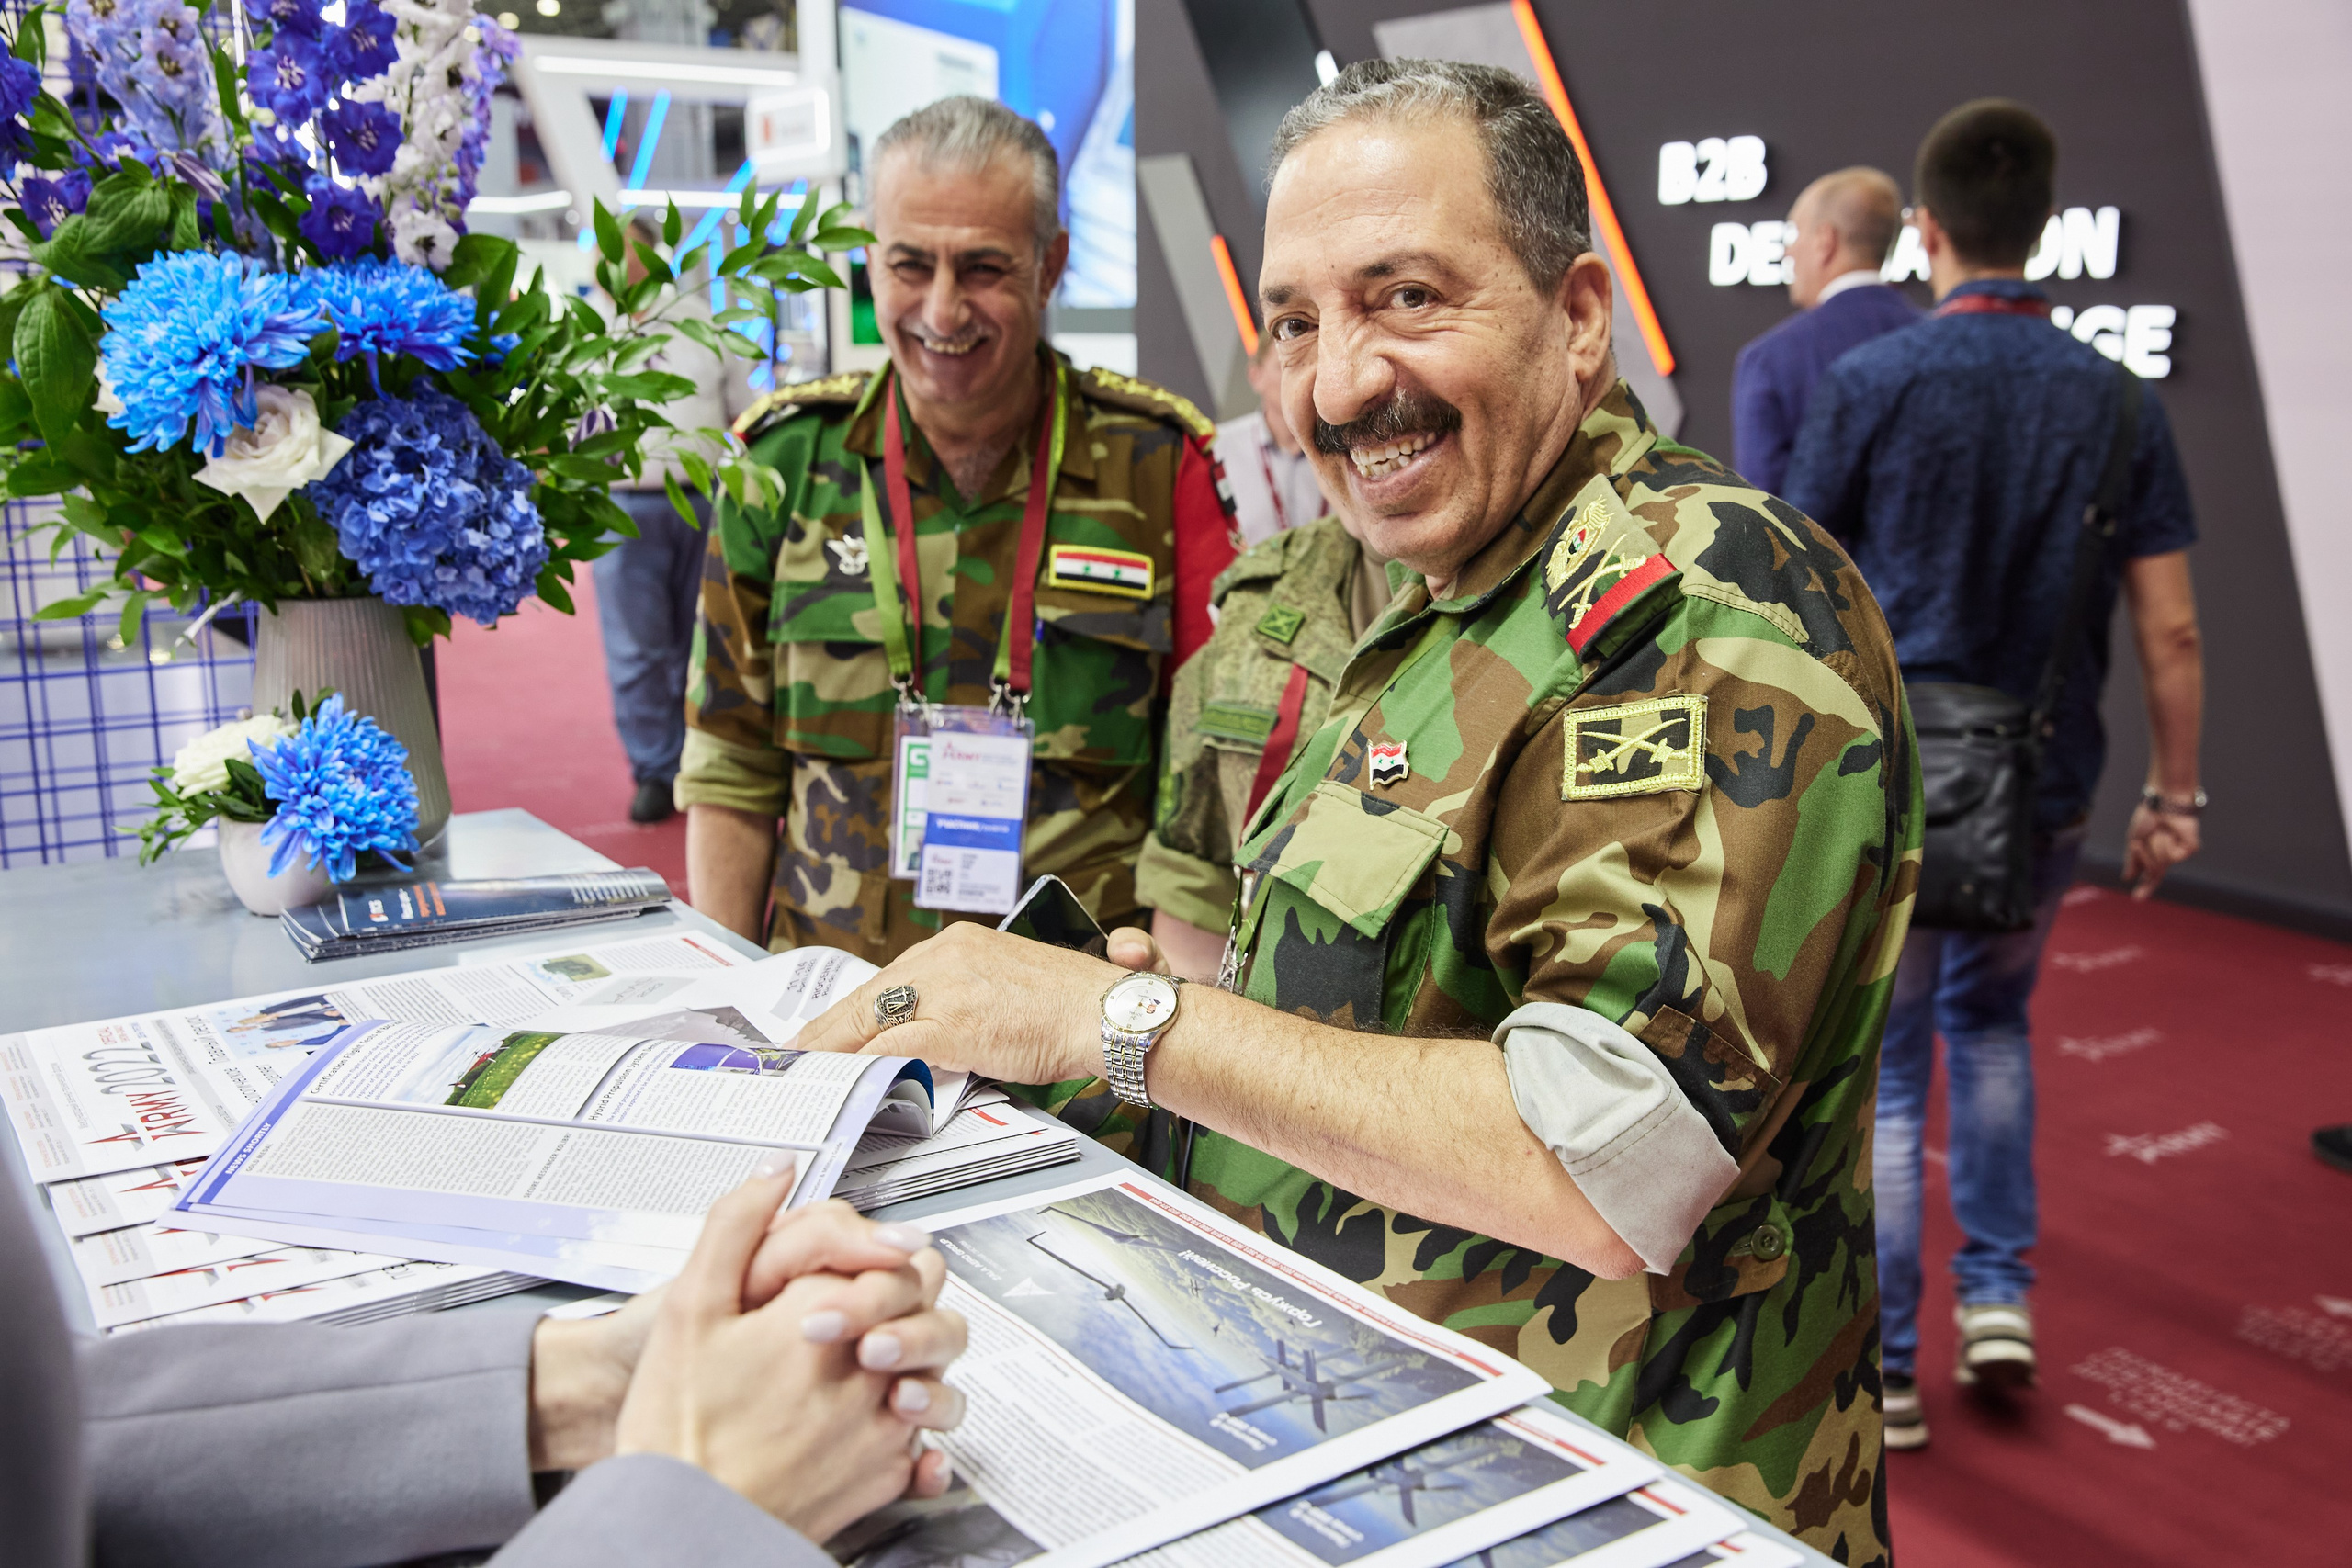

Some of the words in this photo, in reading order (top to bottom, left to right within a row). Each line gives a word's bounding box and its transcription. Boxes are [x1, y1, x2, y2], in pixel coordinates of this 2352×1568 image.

[1658, 135, 1768, 205] B2B
[82, 1047, 176, 1095] 2022
[309, 1056, 350, 1096] Certification
[588, 1099, 609, 1121] Hybrid
[602, 1067, 633, 1100] Propulsion
[626, 1049, 650, 1069] System
[126, 1089, 209, 1142] ARMY
[224, 1153, 248, 1175] NEWS
[243, 1122, 272, 1154] SHORTLY
[939, 1238, 966, 1256] GROUP
[1177, 1248, 1252, 1291] Россией!
[1250, 1286, 1324, 1328] Горжусь
